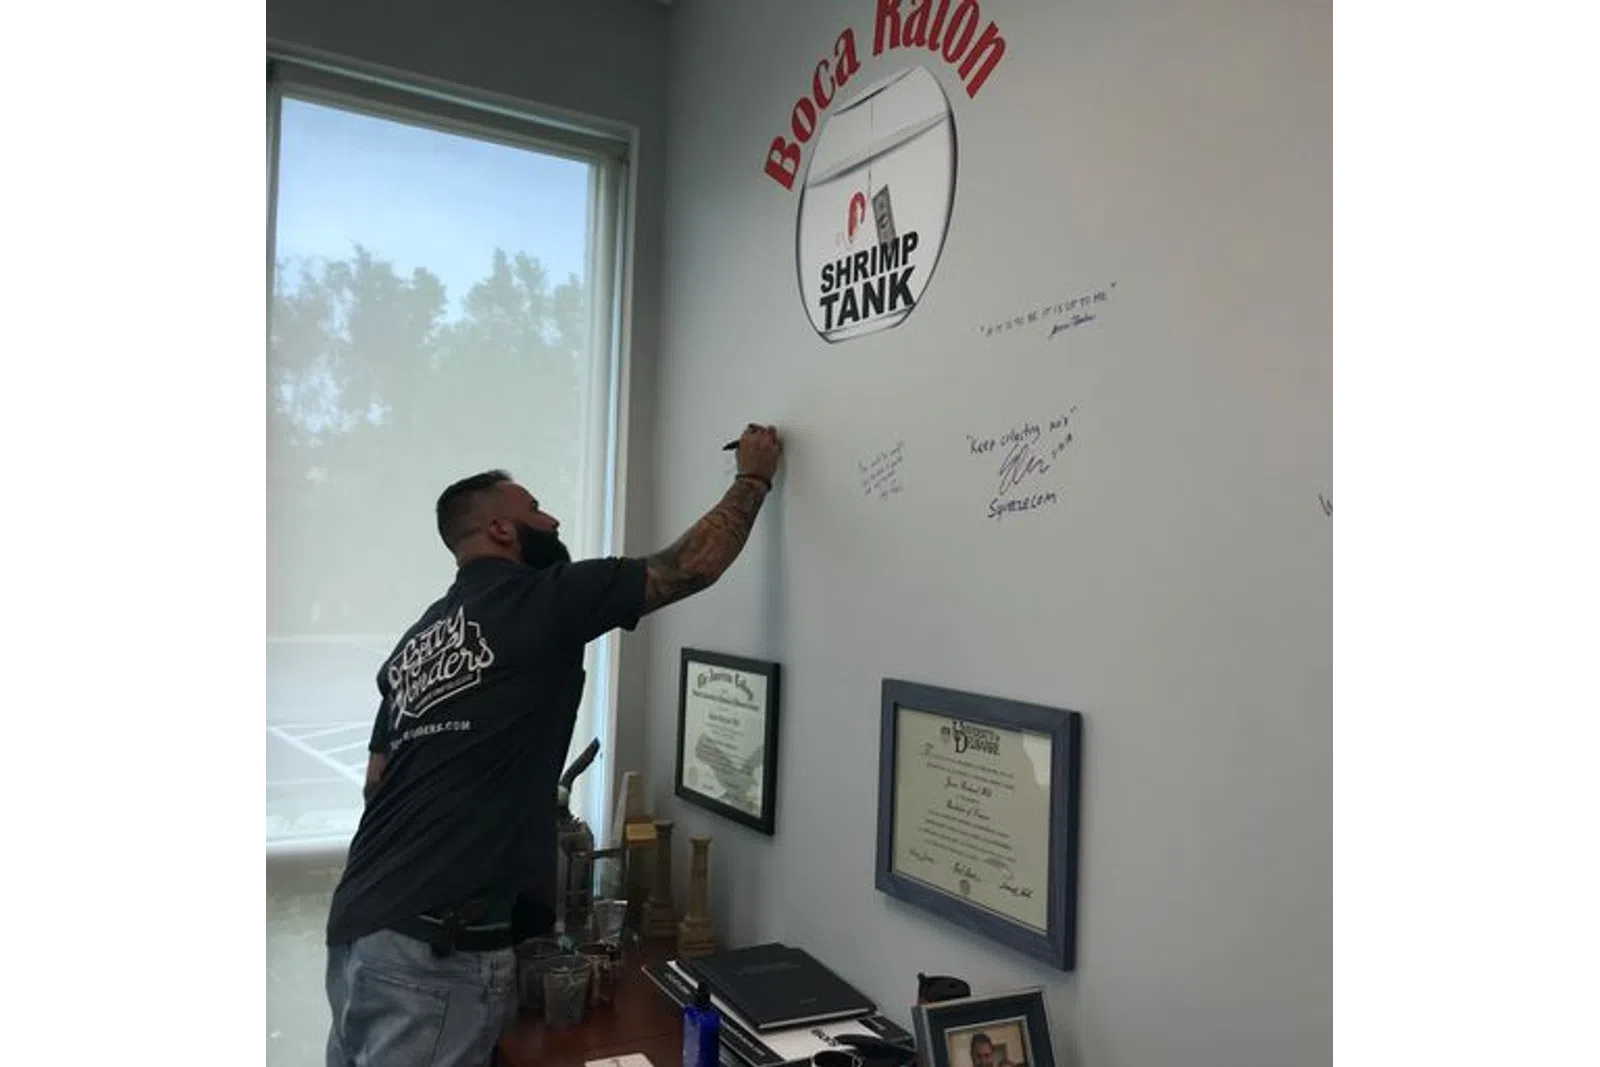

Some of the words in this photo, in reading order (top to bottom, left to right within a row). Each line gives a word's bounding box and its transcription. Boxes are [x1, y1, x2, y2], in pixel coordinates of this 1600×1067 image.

[764, 27, 861, 192] Boca
[820, 231, 919, 293] SHRIMP
[819, 265, 917, 331] TANK
